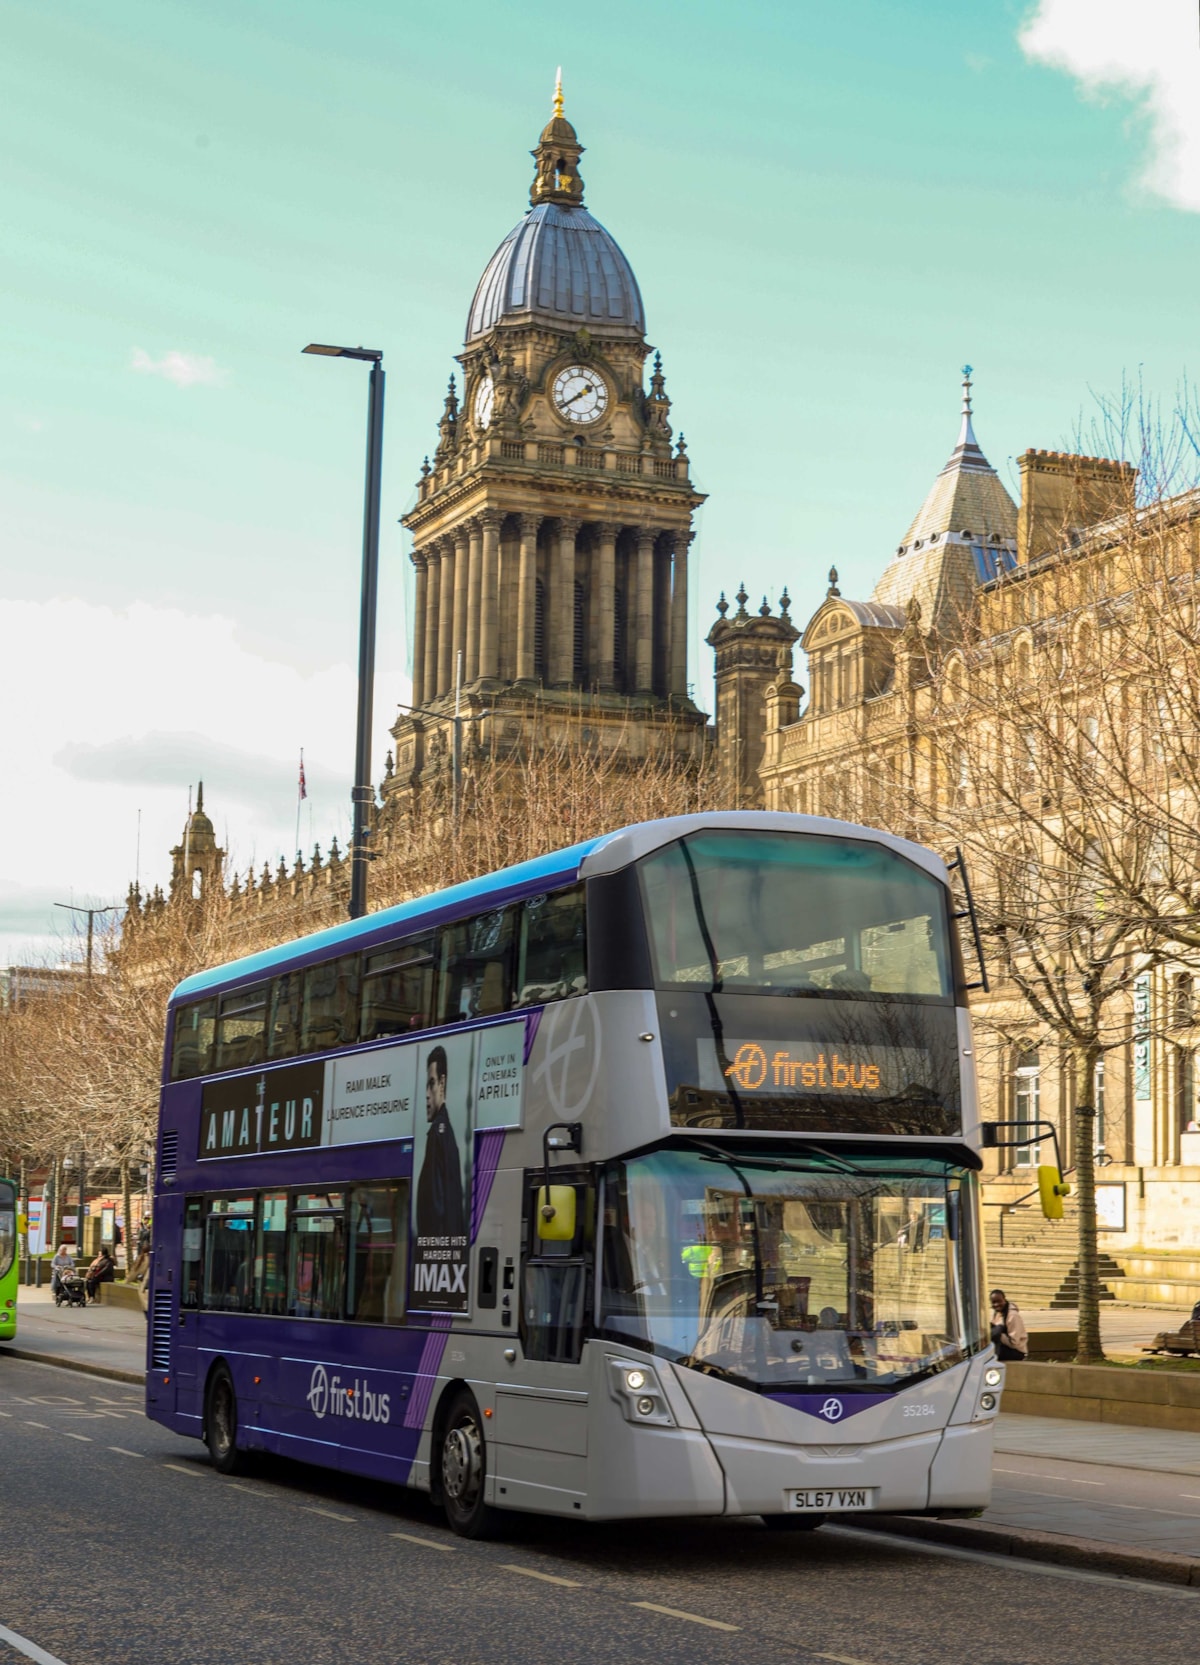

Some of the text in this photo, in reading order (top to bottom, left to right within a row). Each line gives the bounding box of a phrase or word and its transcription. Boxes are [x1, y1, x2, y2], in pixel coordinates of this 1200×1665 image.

[486, 1053, 516, 1067] ONLY IN
[482, 1068, 516, 1081] CINEMAS
[771, 1052, 880, 1089] first bus
[346, 1074, 391, 1093] RAMI MALEK
[479, 1083, 519, 1100] APRIL 11
[327, 1098, 409, 1121] LAURENCE FISHBURNE
[206, 1098, 312, 1150] AMATEUR
[417, 1236, 467, 1246] REVENGE HITS
[423, 1250, 461, 1260] HARDER IN
[414, 1264, 467, 1293] IMAX
[330, 1376, 390, 1423] first bus
[903, 1404, 936, 1417] 35284
[796, 1491, 866, 1508] SL67 VXN
